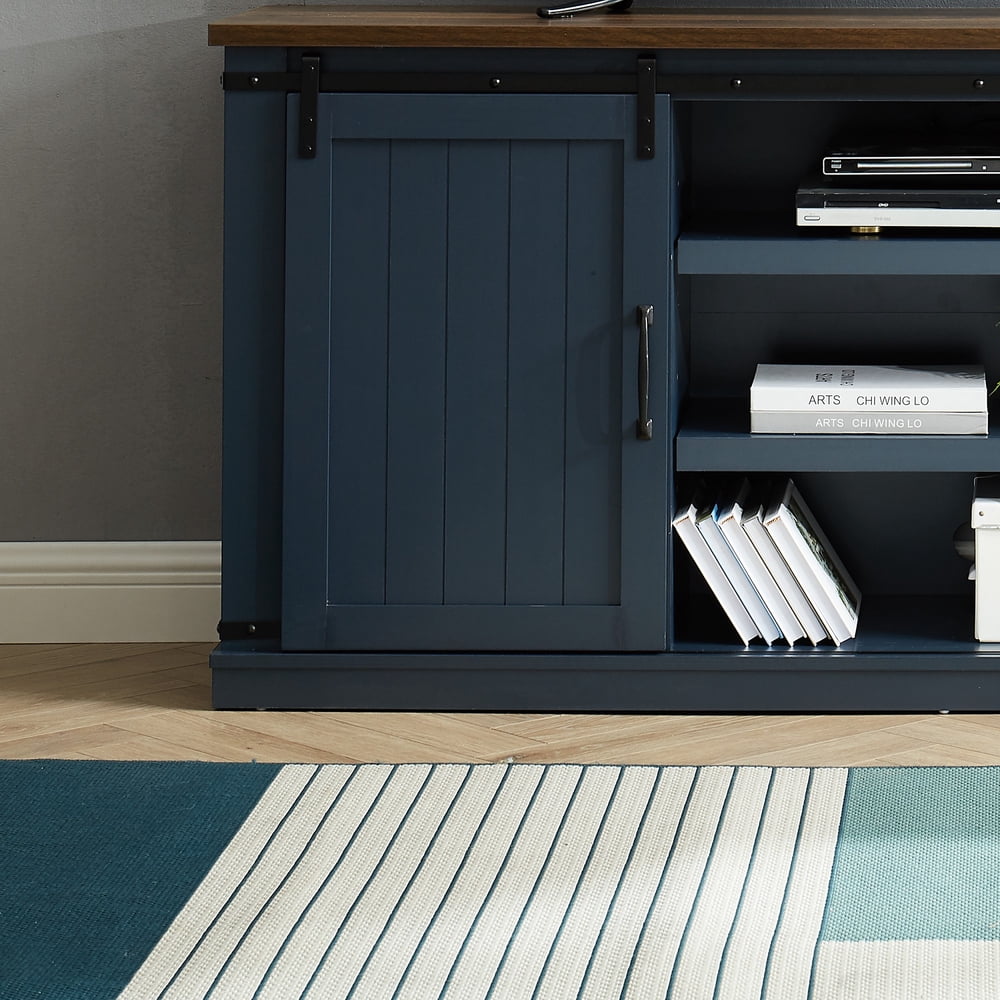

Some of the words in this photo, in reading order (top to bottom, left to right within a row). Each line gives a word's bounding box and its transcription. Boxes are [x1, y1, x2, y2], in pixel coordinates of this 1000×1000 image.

[808, 394, 841, 405] ARTS
[856, 396, 876, 406] CHI
[879, 396, 911, 406] WING
[913, 396, 930, 406] LO
[815, 418, 844, 428] ARTS
[852, 418, 872, 428] CHI
[874, 418, 905, 429] WING
[907, 418, 922, 429] LO
